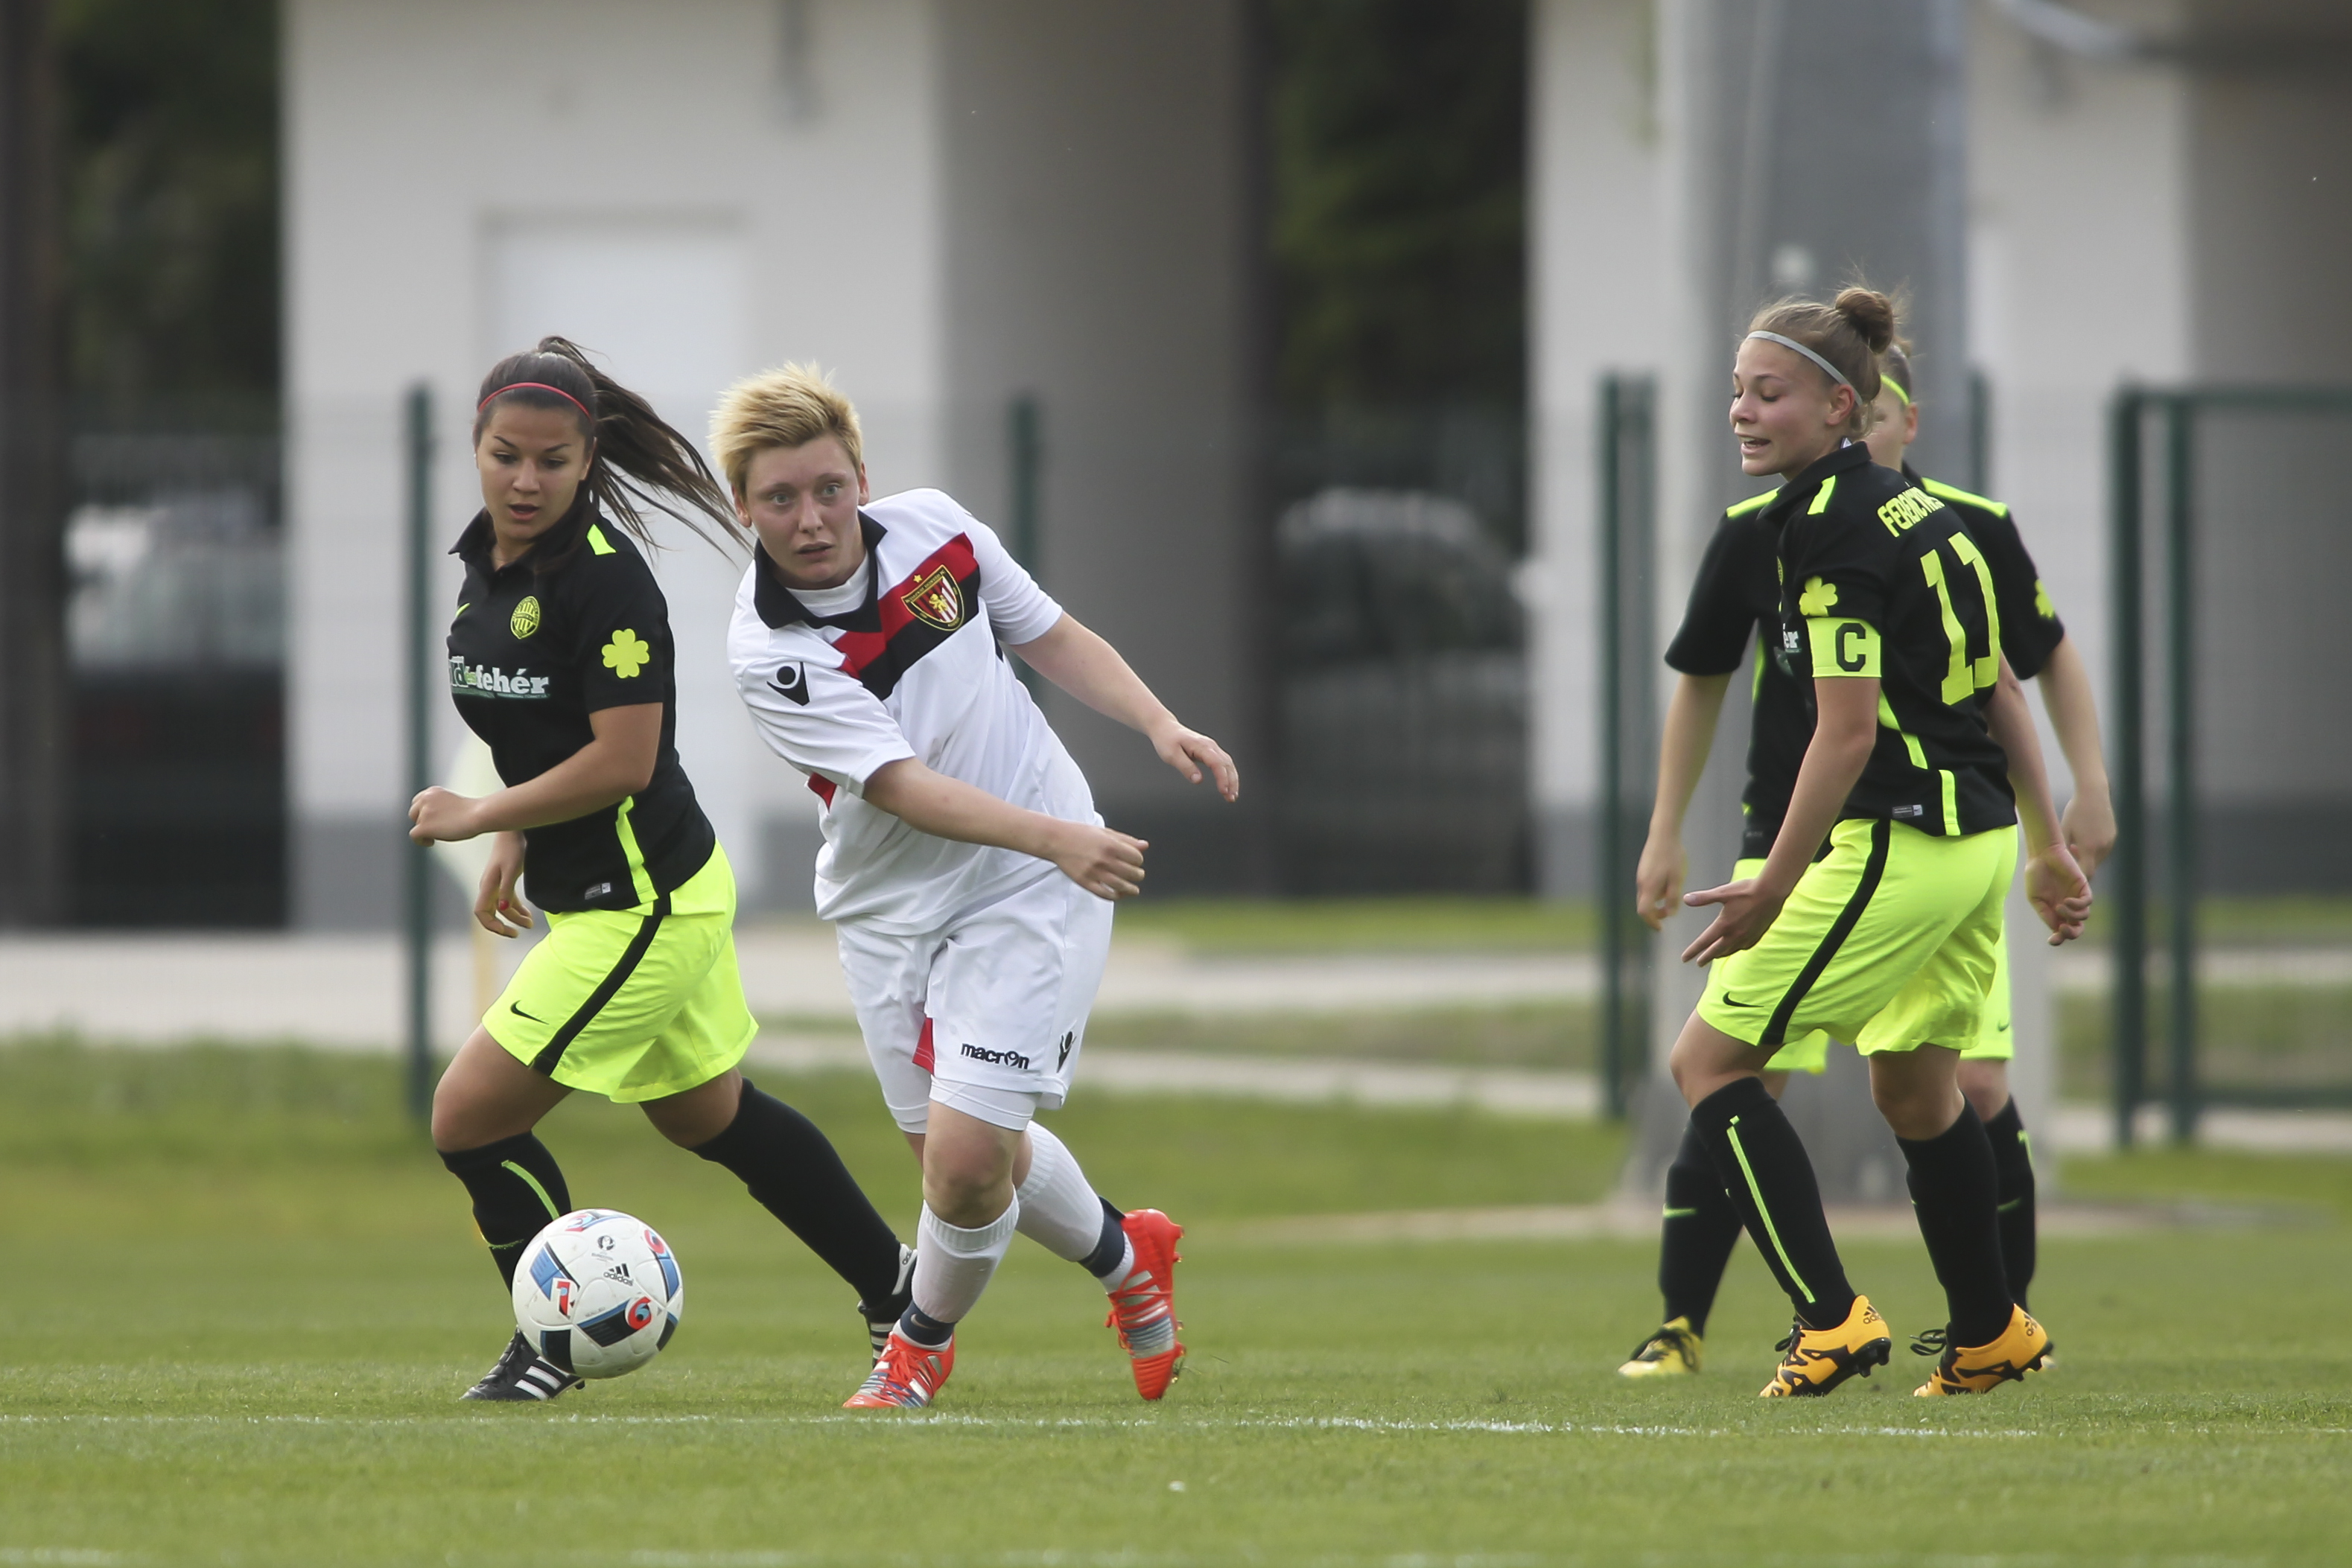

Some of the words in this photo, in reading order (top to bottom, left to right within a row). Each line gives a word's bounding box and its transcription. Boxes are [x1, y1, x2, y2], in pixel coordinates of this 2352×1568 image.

[1835, 622, 1866, 672] C
[961, 1043, 1029, 1069] macron
[603, 1272, 633, 1287] adidas
